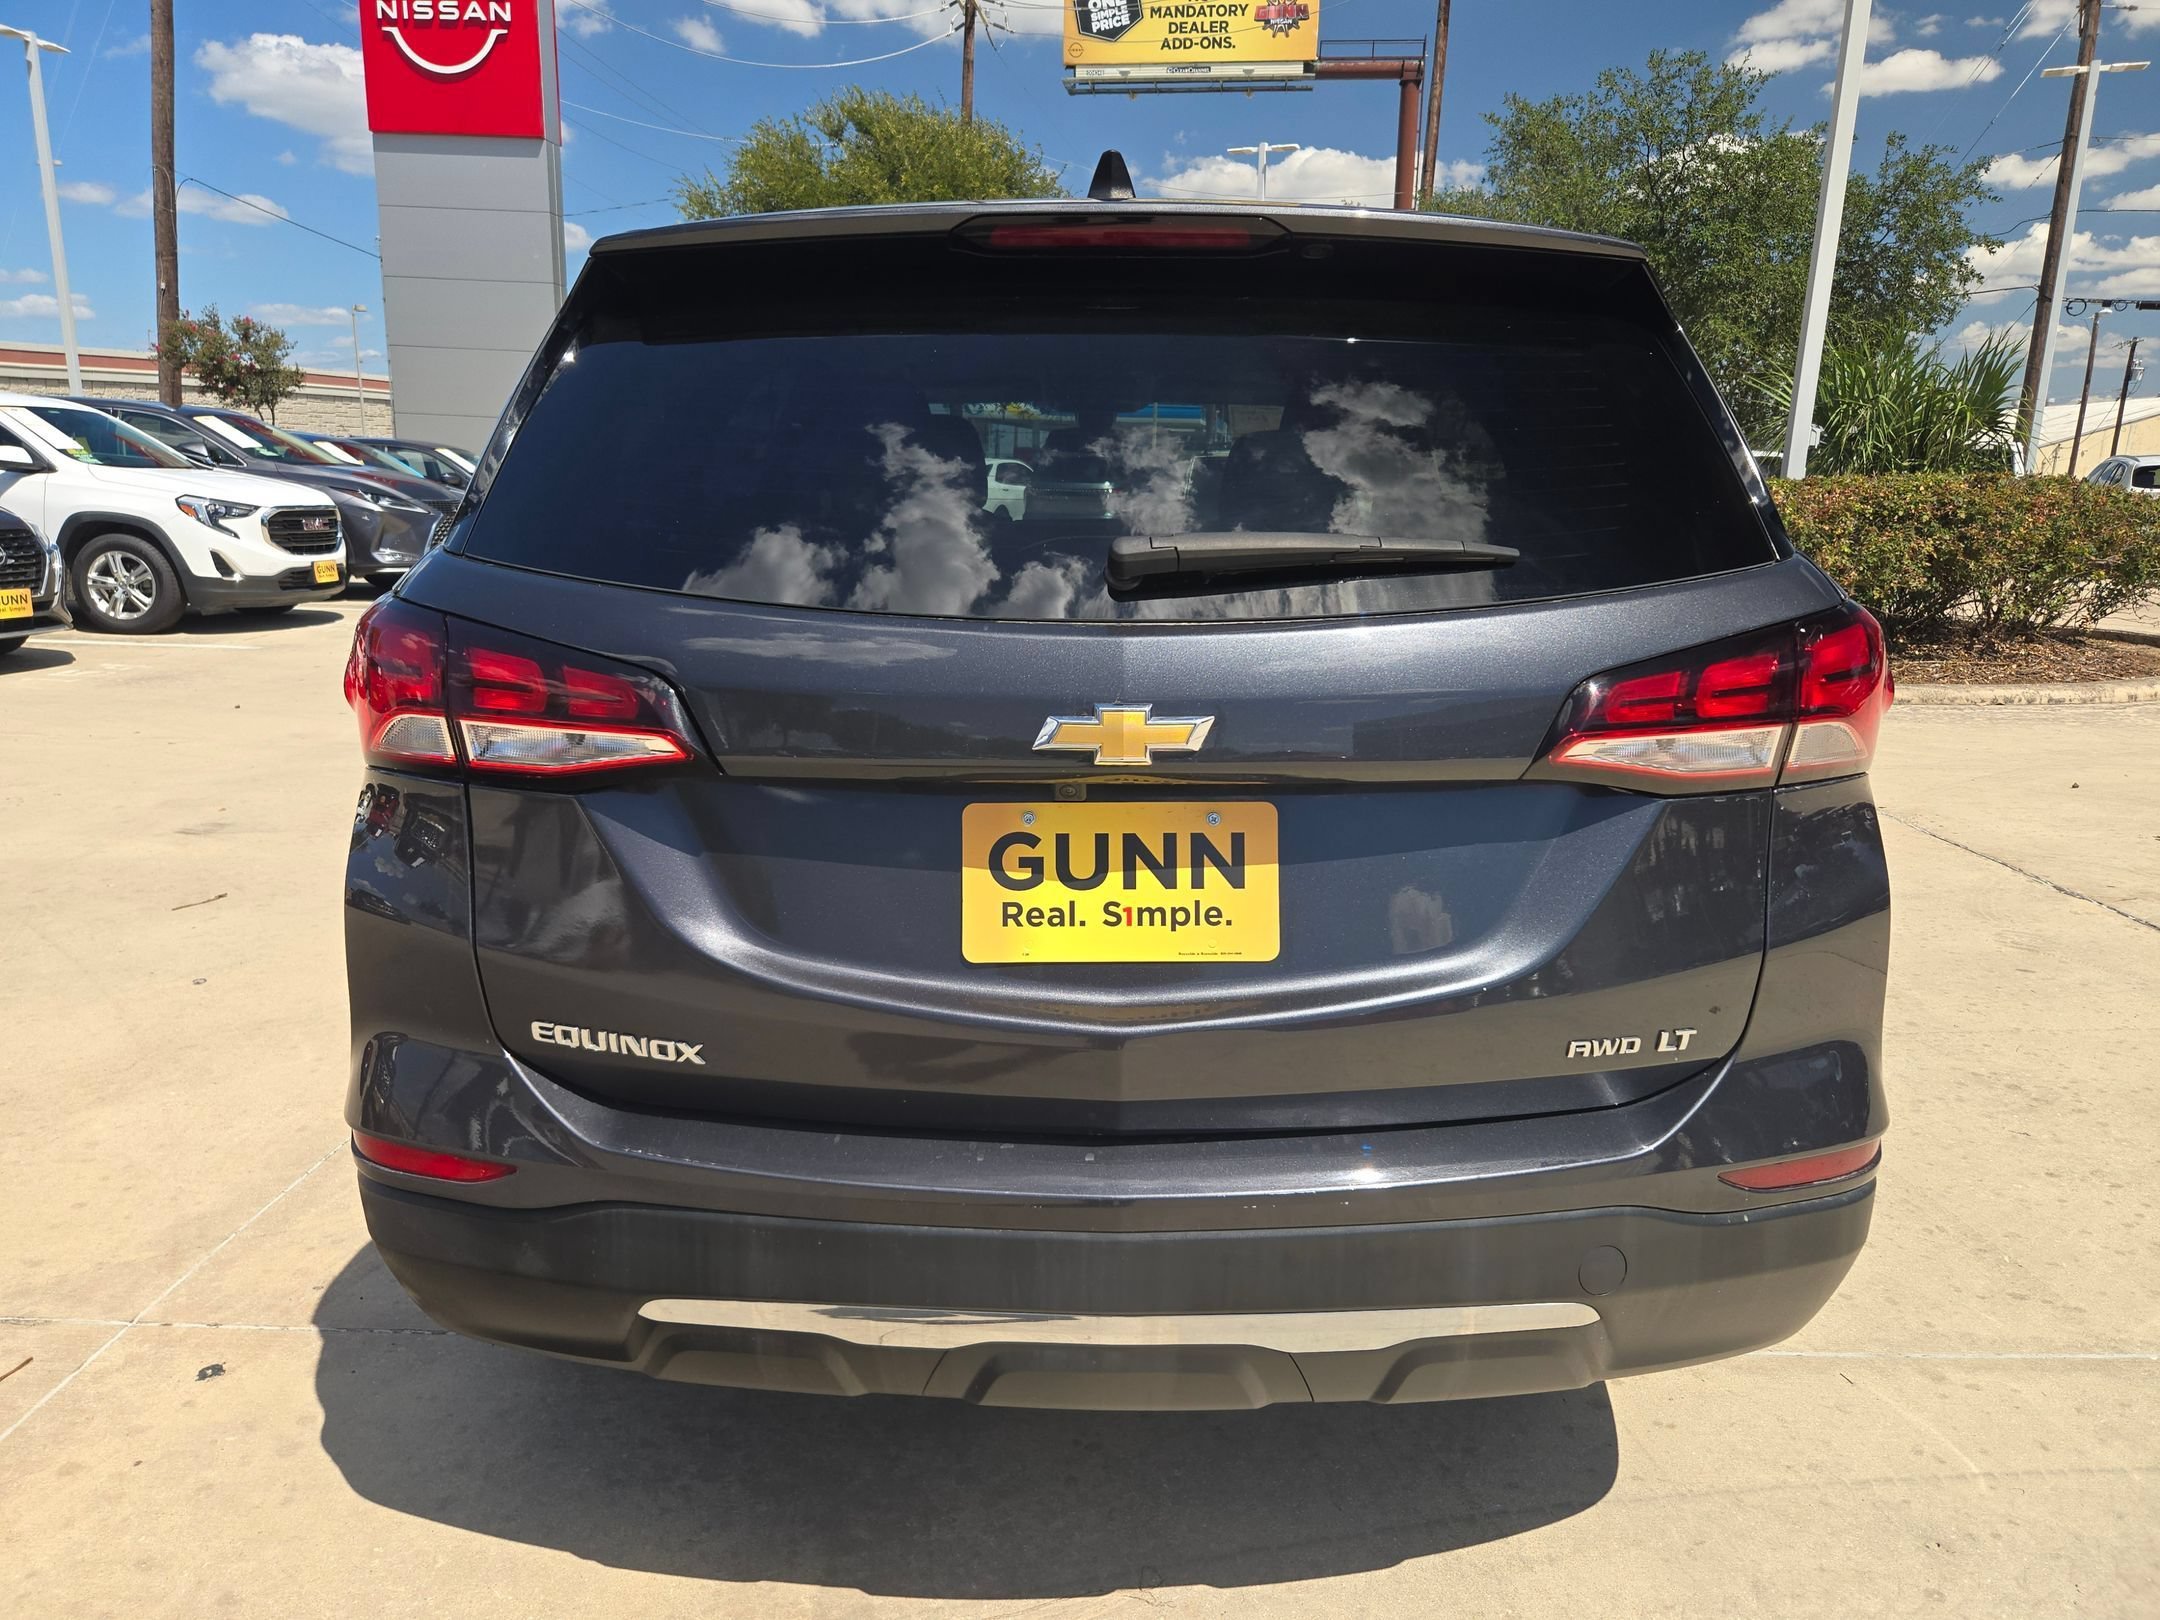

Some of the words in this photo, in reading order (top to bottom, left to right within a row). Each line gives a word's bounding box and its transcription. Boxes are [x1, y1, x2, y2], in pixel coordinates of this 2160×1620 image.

[376, 0, 512, 21] NISSAN
[1090, 5, 1128, 21] SIMPLE
[1150, 4, 1249, 18] MANDATORY
[1254, 4, 1309, 21] GUNN
[1091, 14, 1130, 33] PRICE
[1168, 21, 1229, 34] DEALER
[1160, 36, 1236, 50] ADD-ONS.
[0, 594, 28, 605] UNN
[988, 831, 1245, 892] GUNN
[1002, 901, 1086, 927] Real.
[531, 1021, 706, 1065] EQUINOX
[1567, 1037, 1641, 1058] AWD
[1657, 1028, 1697, 1052] LT
